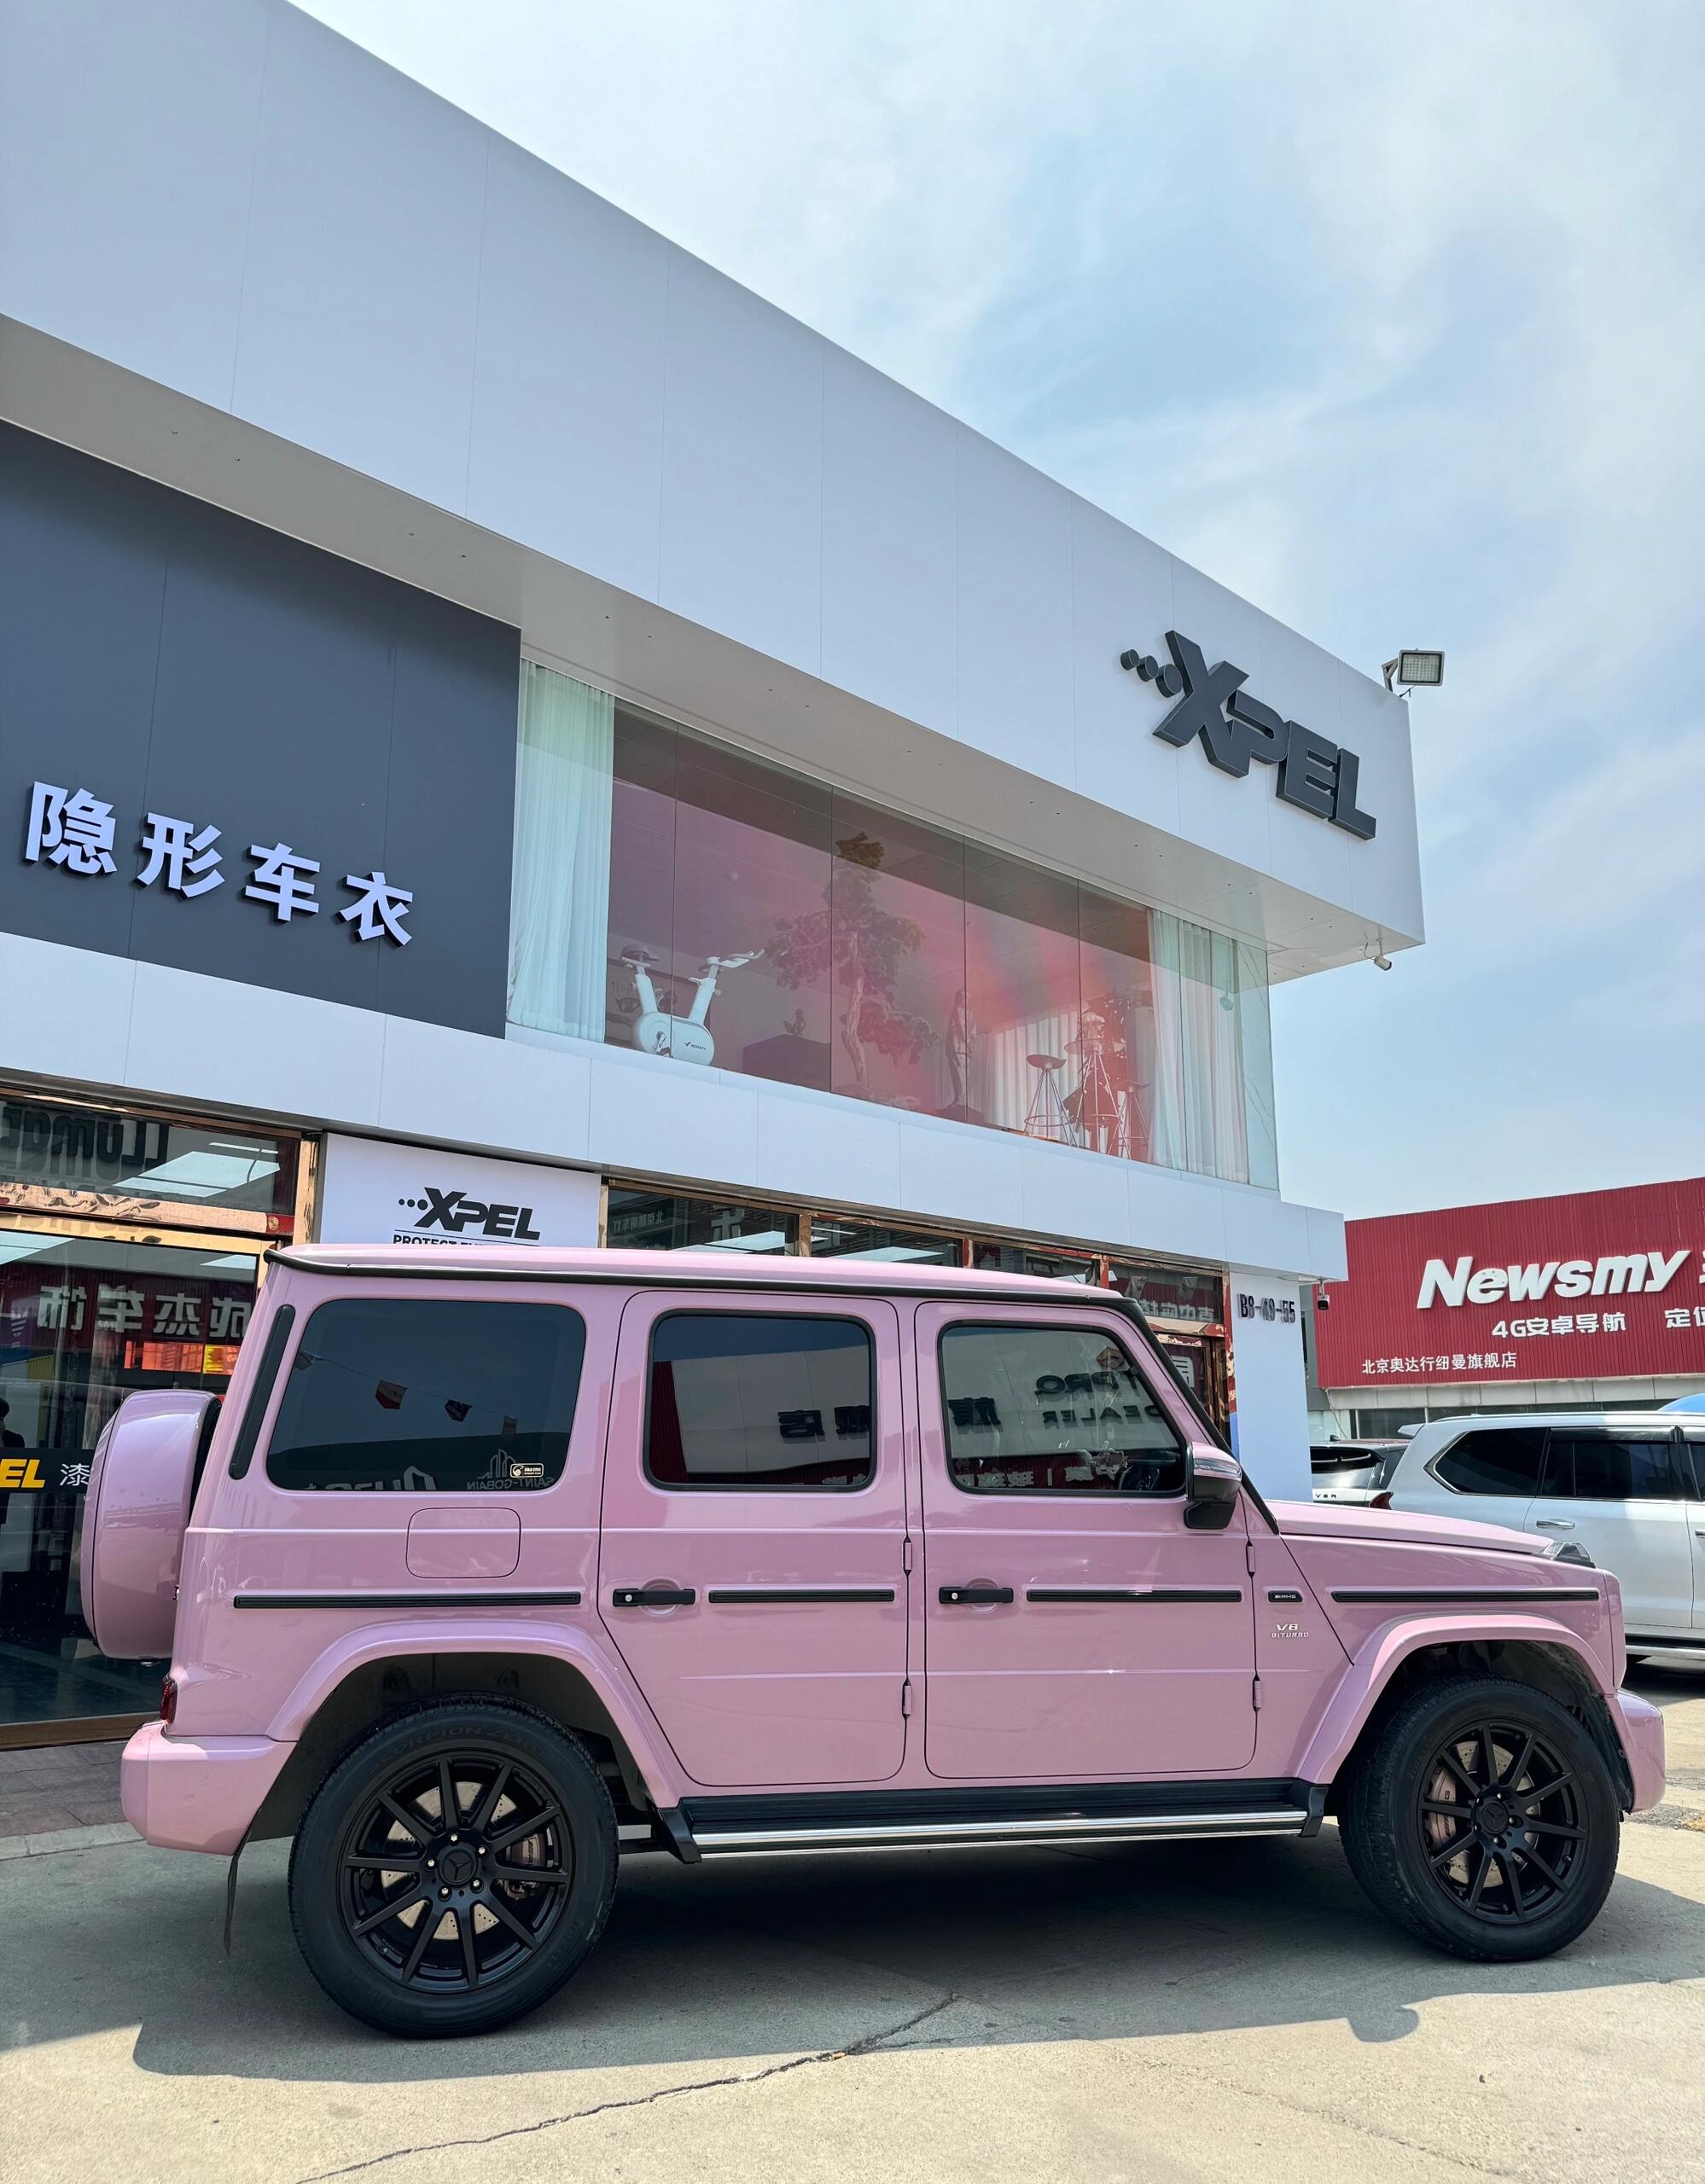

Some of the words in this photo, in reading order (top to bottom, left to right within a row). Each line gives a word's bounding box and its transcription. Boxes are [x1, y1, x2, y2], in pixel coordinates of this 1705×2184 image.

[1152, 630, 1376, 841] XPEL
[24, 781, 414, 946] 隐形车衣
[414, 1187, 541, 1240] XPEL
[1417, 1250, 1692, 1310] Newsmy
[1492, 1312, 1626, 1339] 4G安卓导航
[60, 1462, 90, 1486] 漆
[1276, 1623, 1299, 1631] V8
